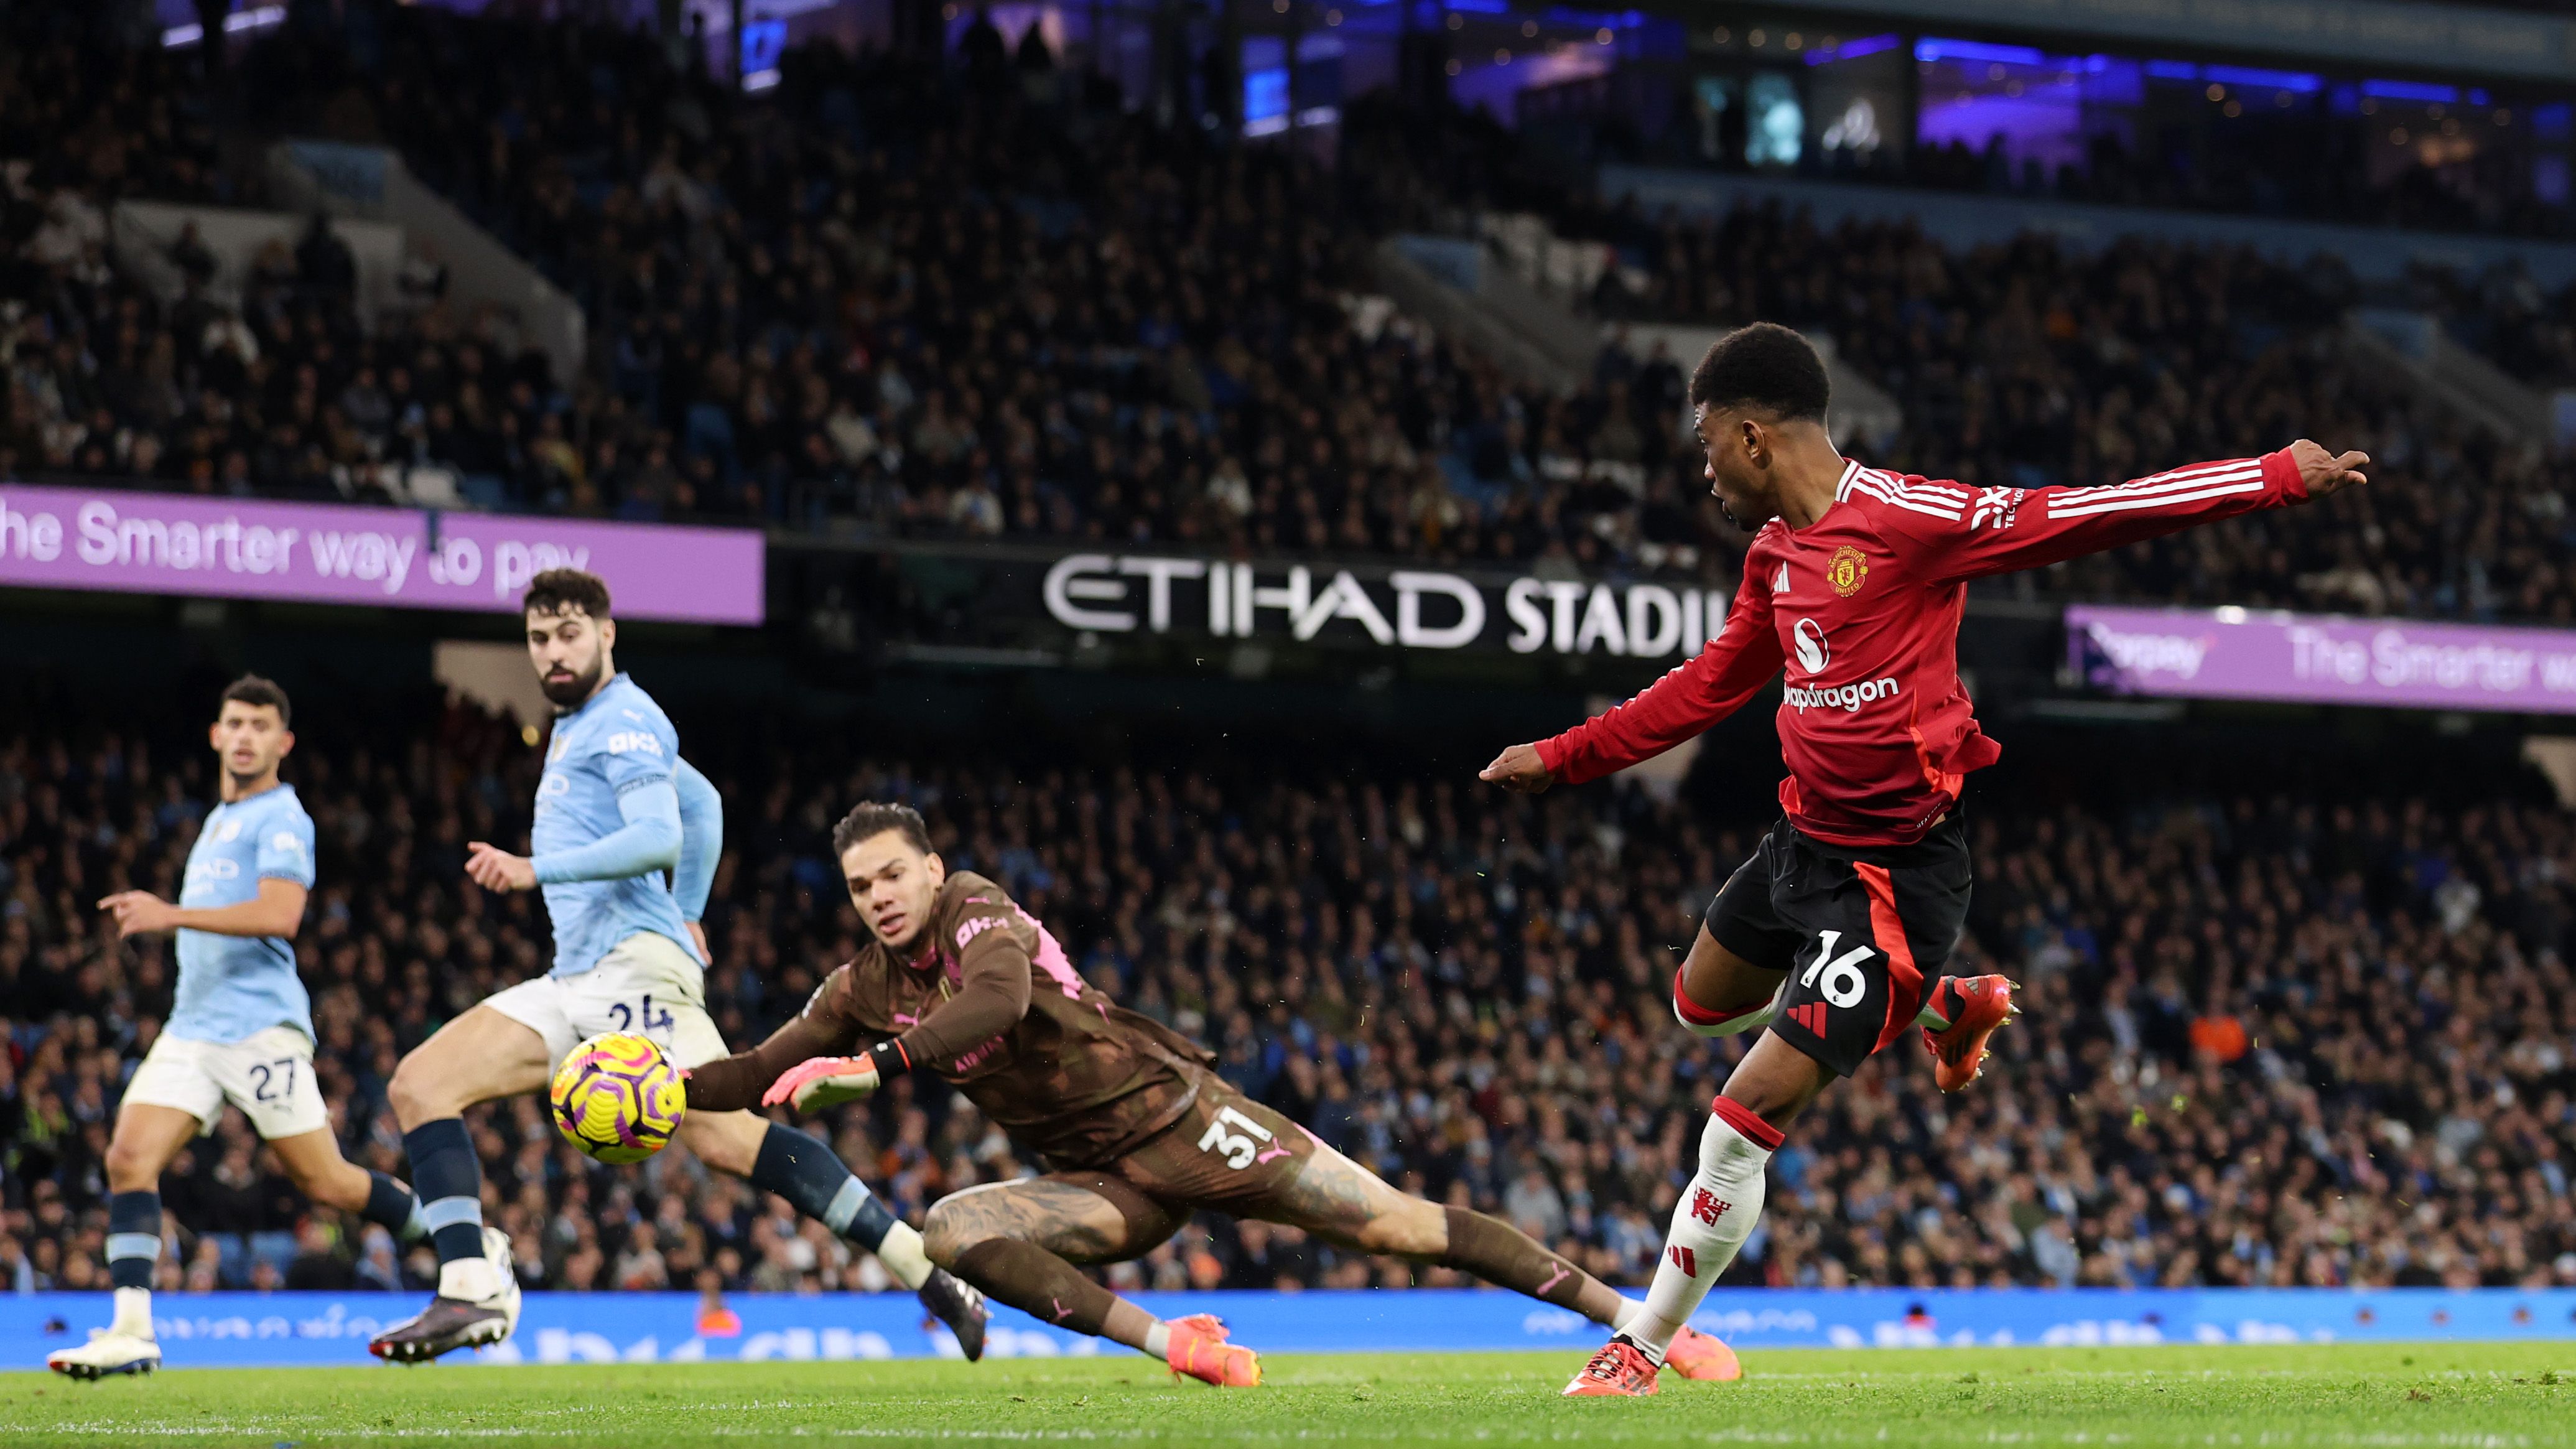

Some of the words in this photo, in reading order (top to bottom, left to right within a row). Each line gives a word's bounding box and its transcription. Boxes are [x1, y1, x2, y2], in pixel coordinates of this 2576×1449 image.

[75, 501, 299, 574] Smarter
[308, 529, 416, 595] way
[1830, 549, 1863, 569] MANCHESTER
[1043, 554, 1486, 648] ETIHAD
[1835, 582, 1860, 594] UNITED
[1800, 930, 1876, 1009] 16
[608, 994, 674, 1031] 24
[250, 1058, 294, 1101] 27
[1197, 1106, 1273, 1170] 31
